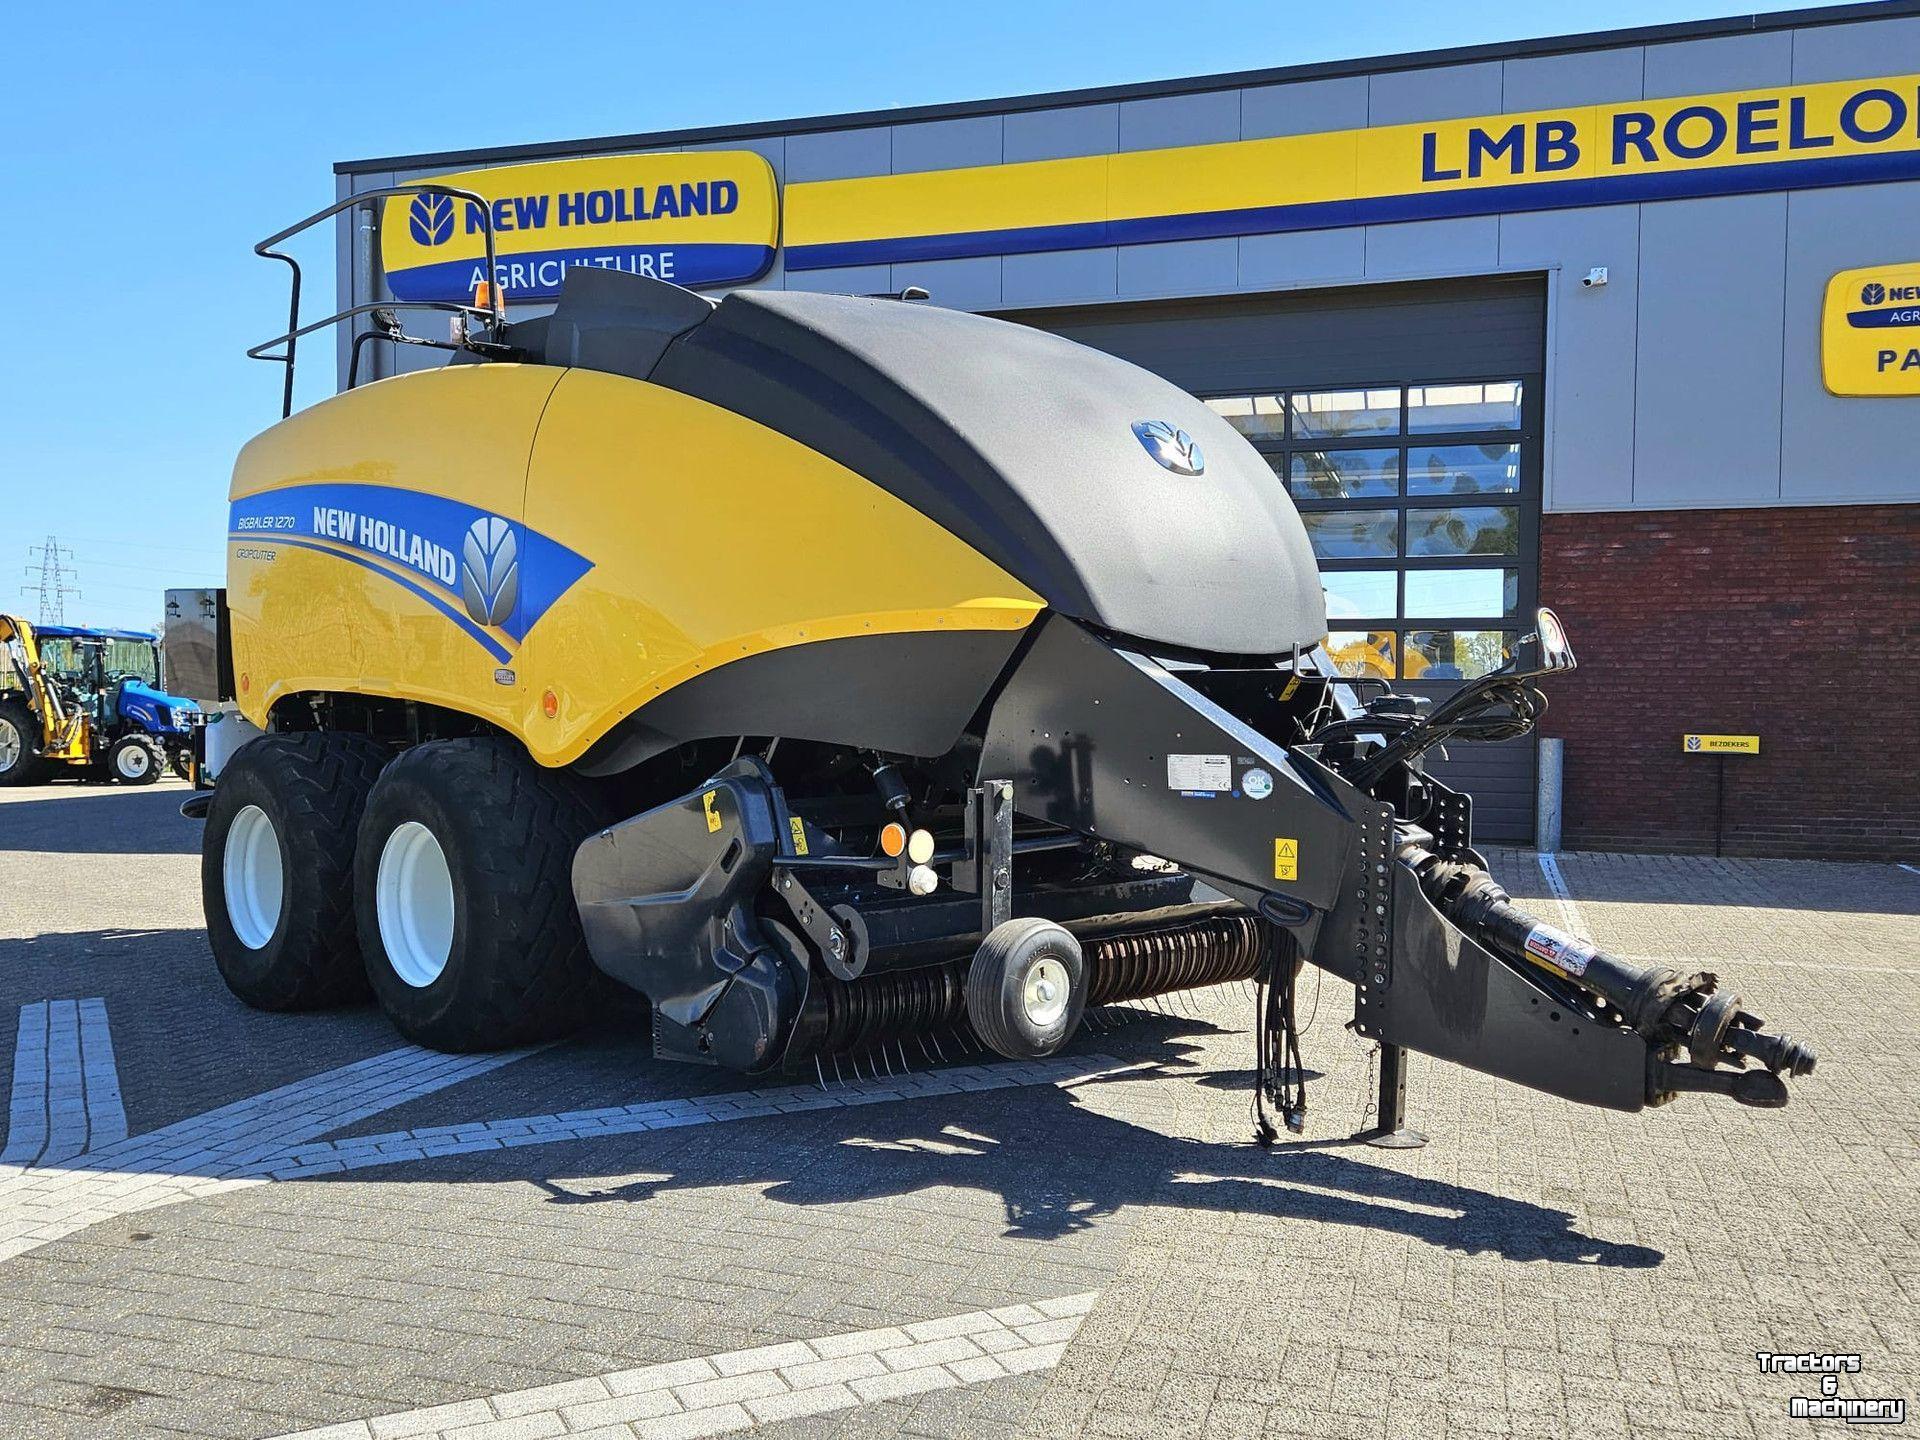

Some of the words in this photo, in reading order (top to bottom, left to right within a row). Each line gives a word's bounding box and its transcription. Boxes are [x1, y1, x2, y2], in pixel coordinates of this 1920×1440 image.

[1422, 120, 1580, 182] LMB
[1612, 86, 1920, 165] ROELO
[465, 195, 549, 235] NEW
[558, 180, 738, 227] HOLLAND
[468, 252, 675, 292] AGRICTURE
[1889, 286, 1920, 301] NE
[238, 517, 273, 530] BIGBALER
[275, 517, 295, 529] 1270
[236, 548, 276, 561] CROPCUTTER
[313, 506, 356, 541] NEW
[360, 515, 456, 586] HOLLAND
[1248, 776, 1265, 785] OK
